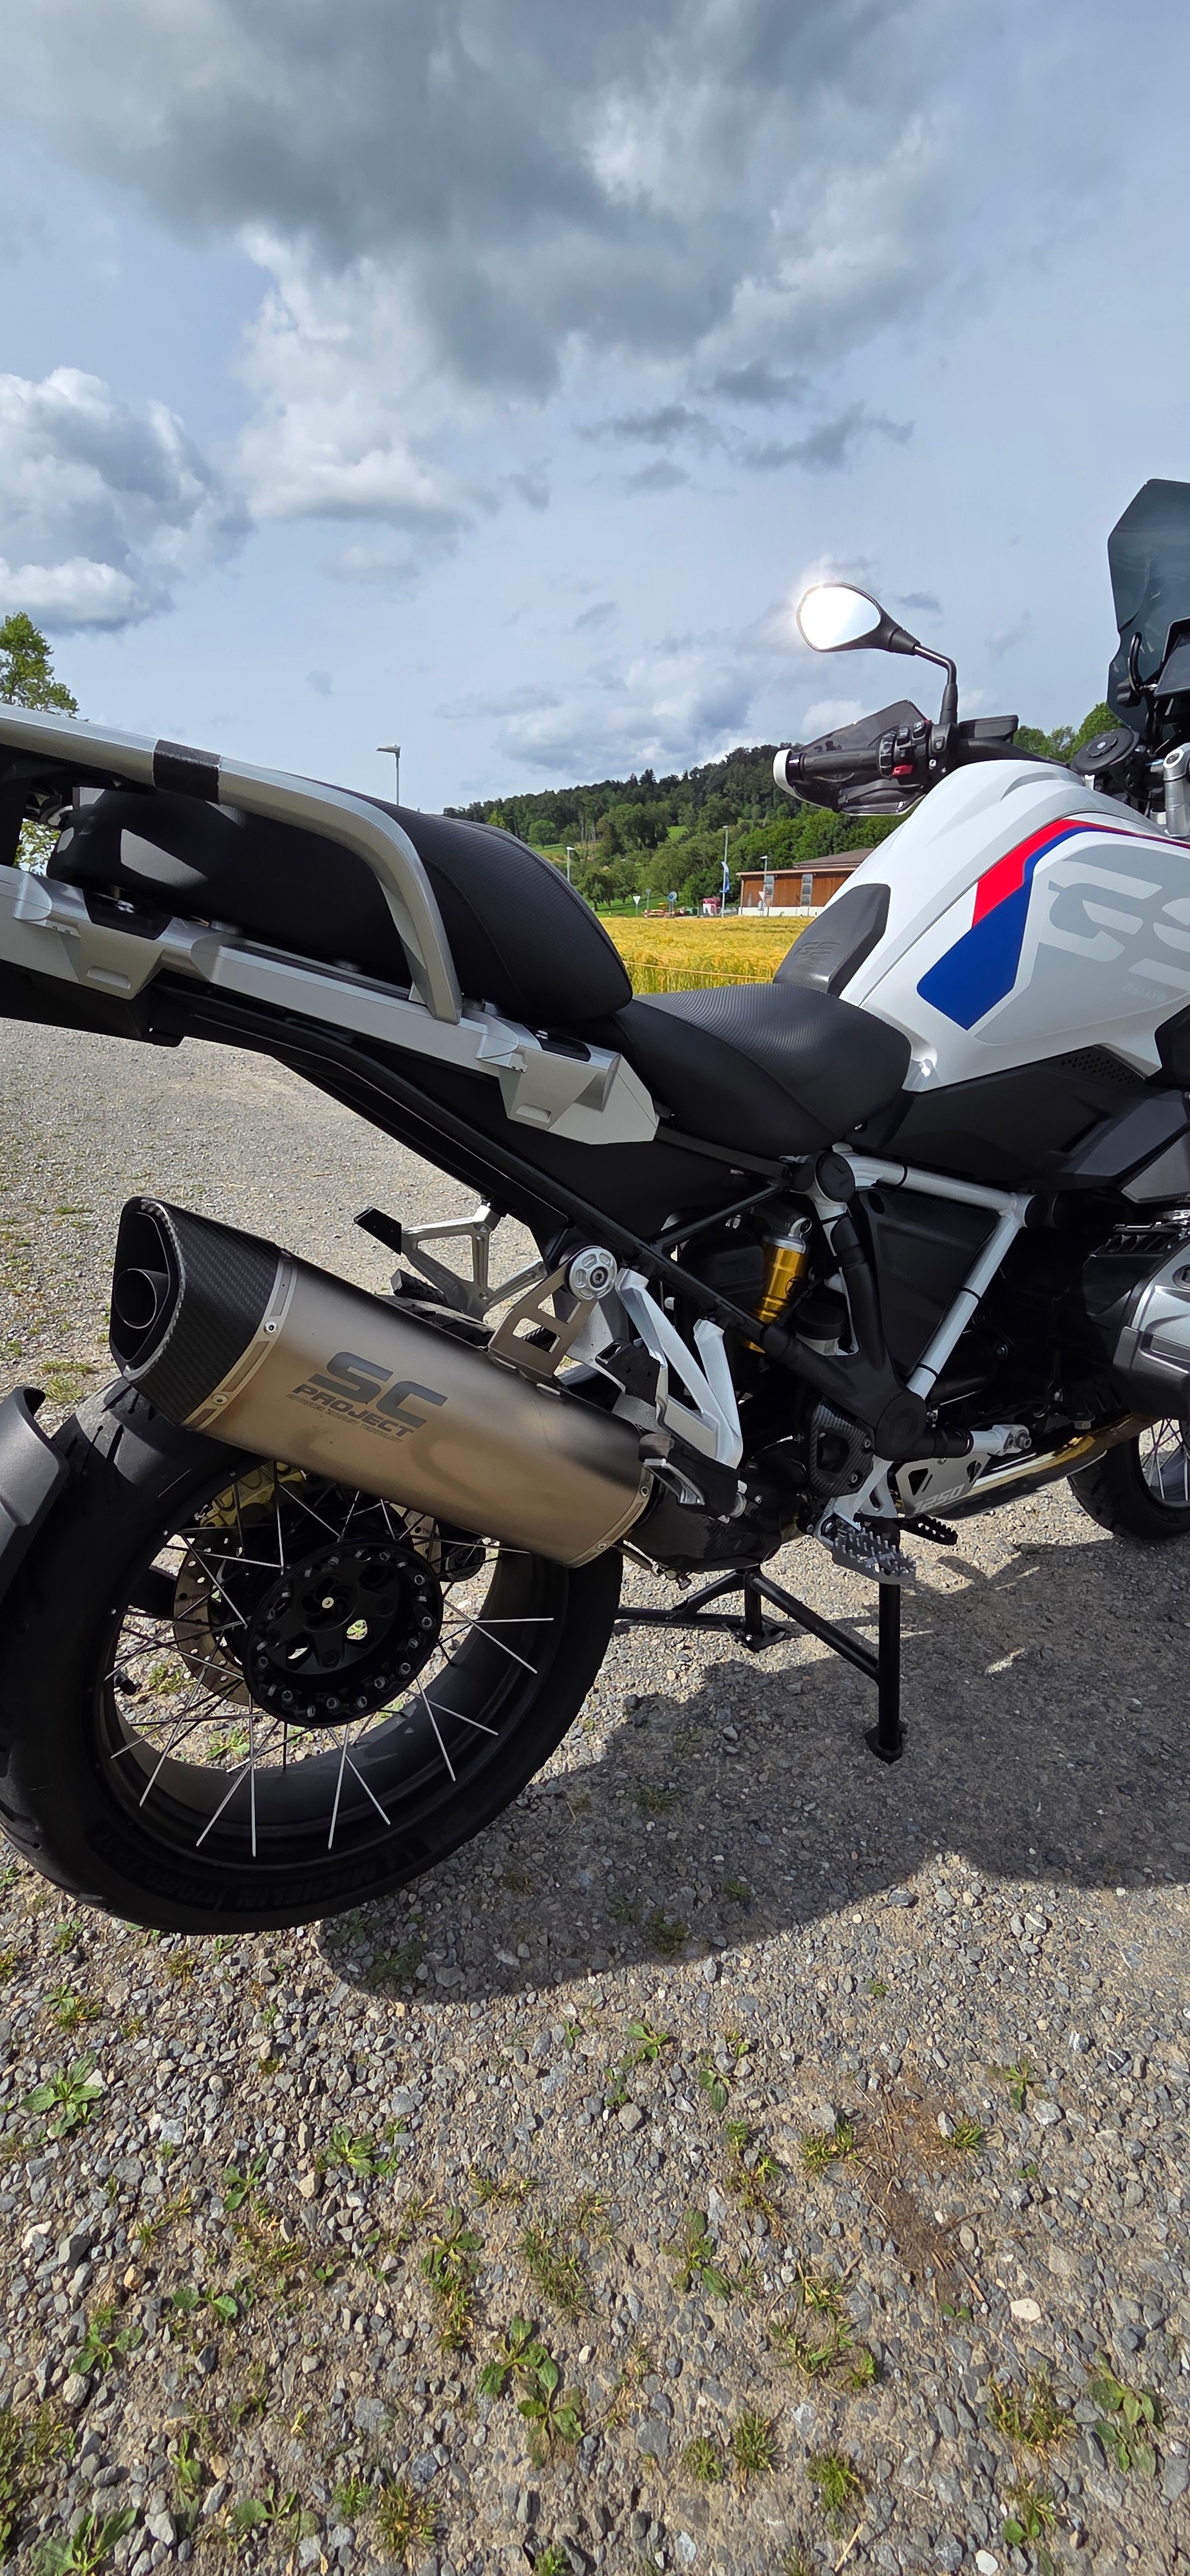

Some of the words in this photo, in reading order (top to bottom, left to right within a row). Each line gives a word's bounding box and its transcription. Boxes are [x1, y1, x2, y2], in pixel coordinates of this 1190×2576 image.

[292, 1383, 415, 1437] PROJECT
[307, 1351, 448, 1429] SC
[912, 1483, 965, 1515] 1250
[144, 1867, 217, 1904] 170/60
[235, 1860, 377, 1908] MICHELIN
